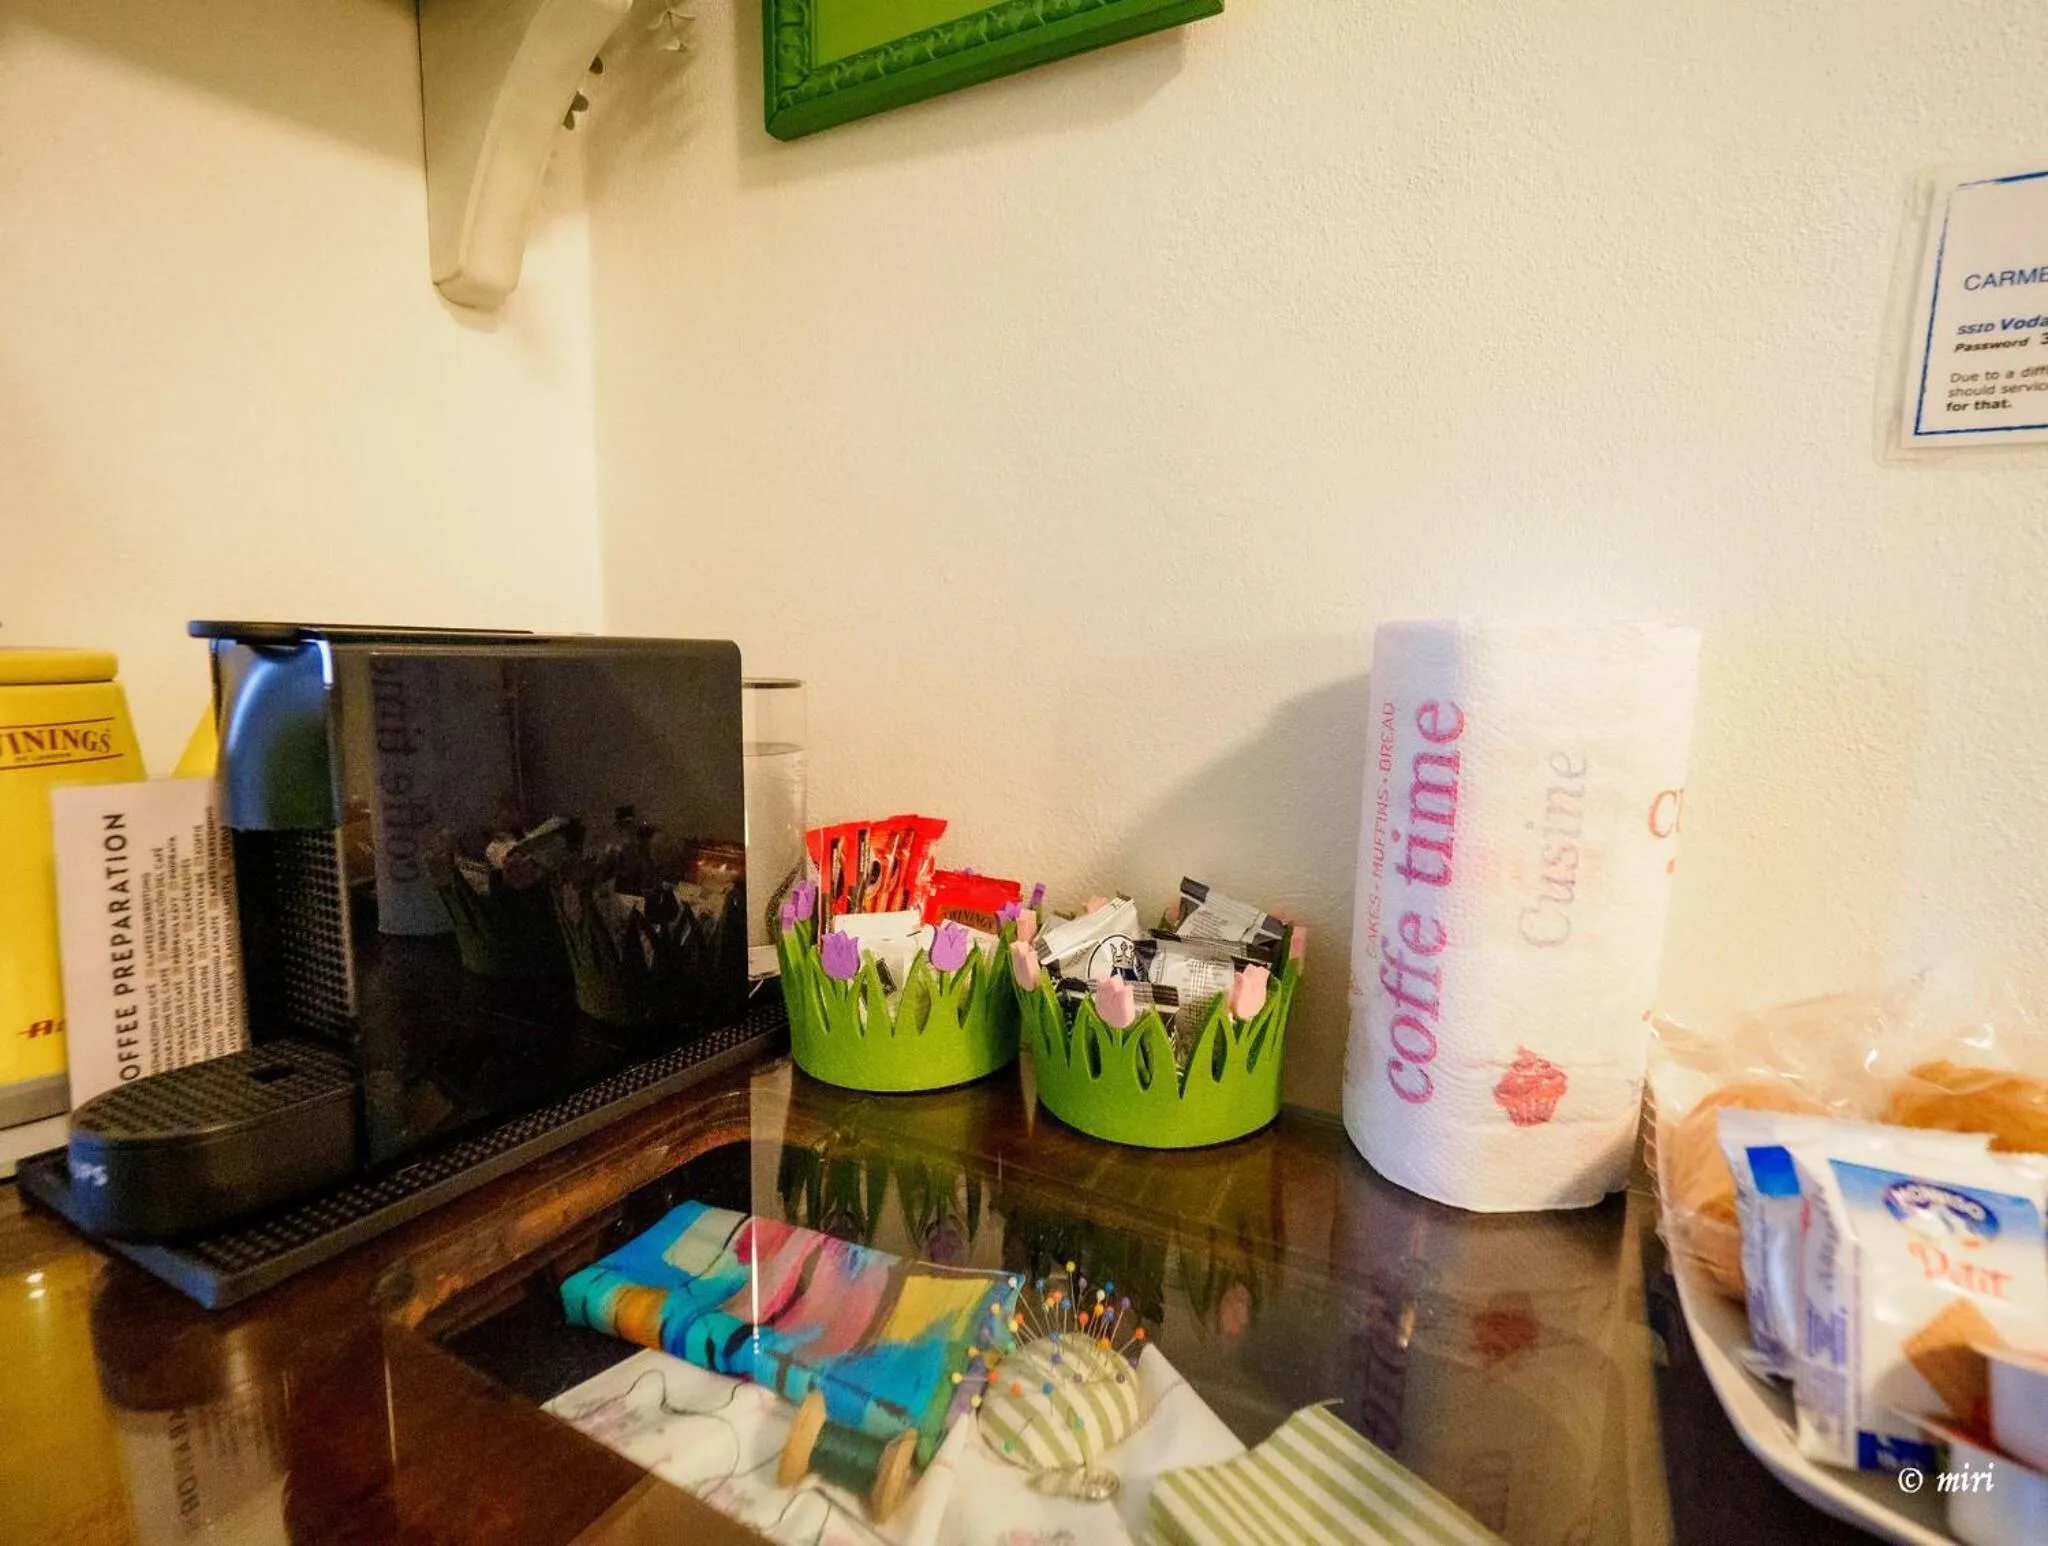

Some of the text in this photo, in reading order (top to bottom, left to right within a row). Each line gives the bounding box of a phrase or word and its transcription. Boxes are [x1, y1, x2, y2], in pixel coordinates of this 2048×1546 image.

[1964, 266, 2048, 291] CARME
[1956, 322, 1996, 335] SSID
[1953, 337, 2030, 353] Password
[1950, 372, 1979, 383] Due
[1985, 371, 2000, 380] to
[2005, 370, 2015, 379] a
[1948, 384, 1996, 397] should
[1946, 400, 2012, 411] for that.
[0, 729, 112, 756] ININGS
[1379, 702, 1396, 773] BREAD
[1373, 792, 1391, 880] MUFFINS
[1518, 751, 1589, 949] Cusine
[102, 813, 135, 996] PREPARATION
[1379, 701, 1465, 1104] coffe time
